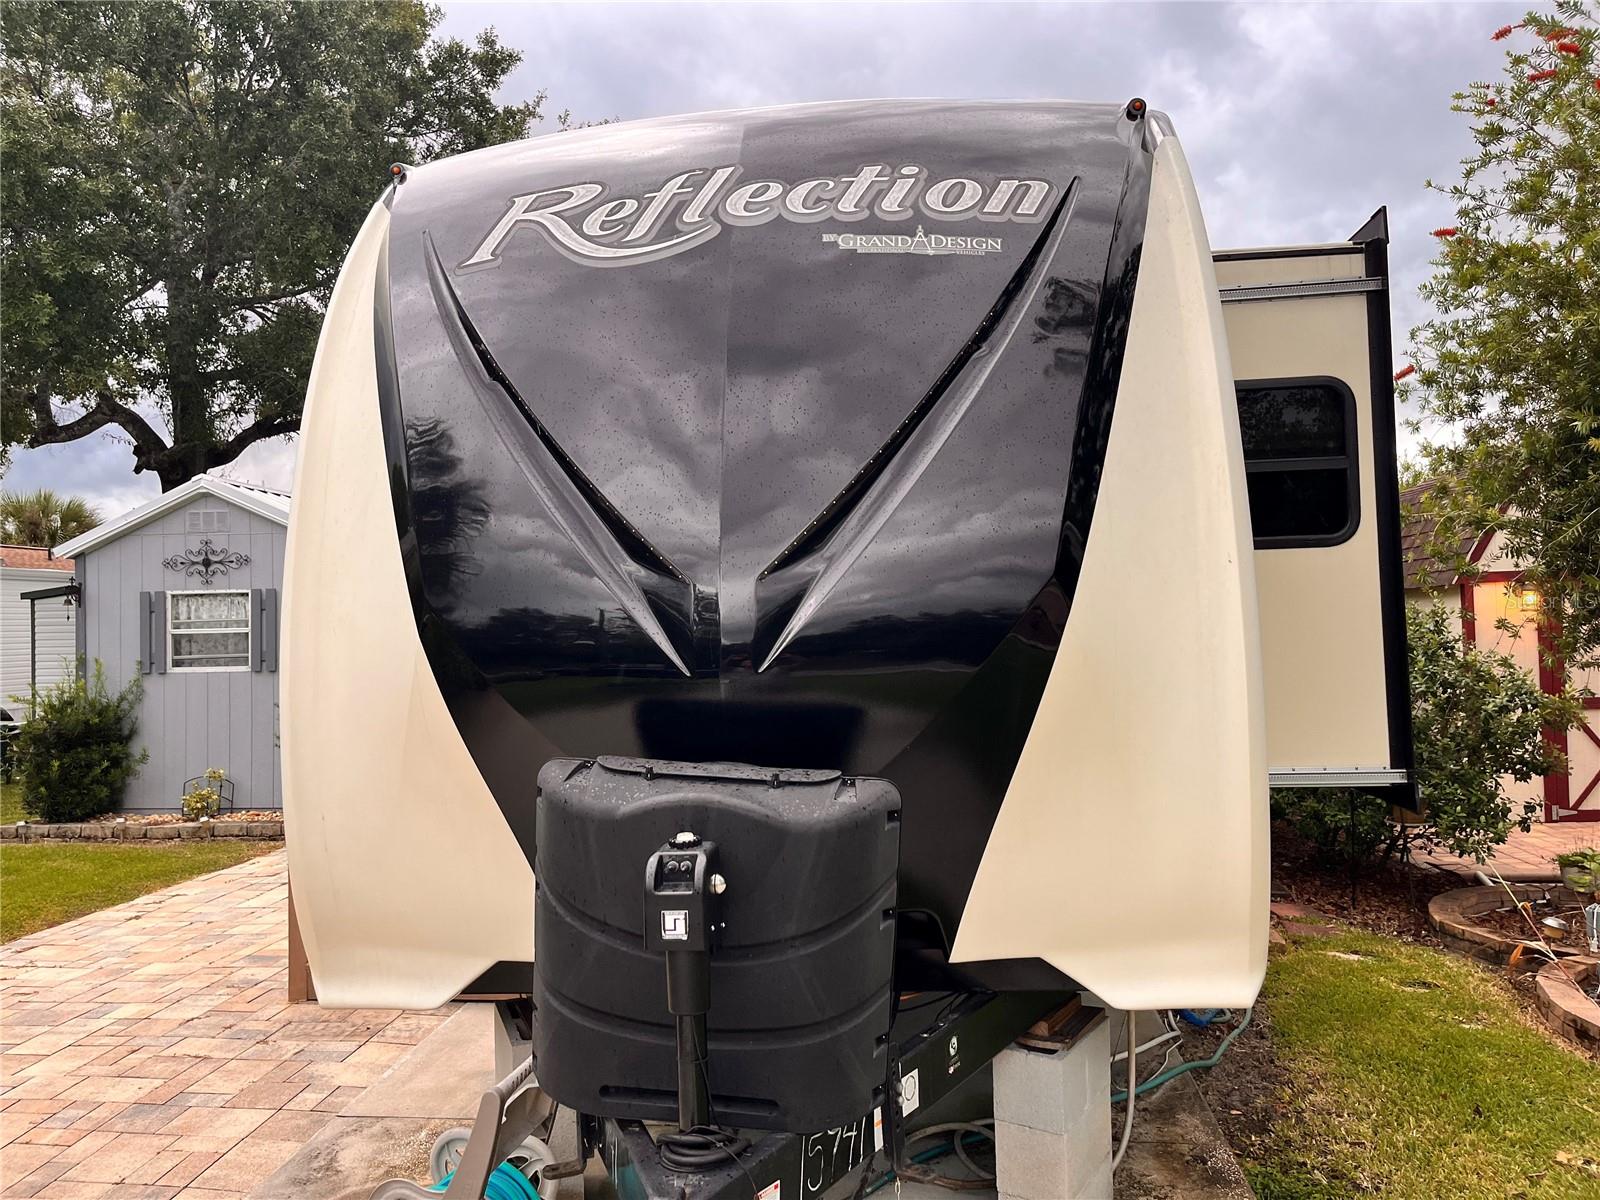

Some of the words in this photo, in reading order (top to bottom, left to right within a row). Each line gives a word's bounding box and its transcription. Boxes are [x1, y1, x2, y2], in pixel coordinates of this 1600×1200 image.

[458, 164, 1054, 270] Reflection
[838, 233, 912, 247] GRAND
[930, 234, 1002, 250] DESIGN
